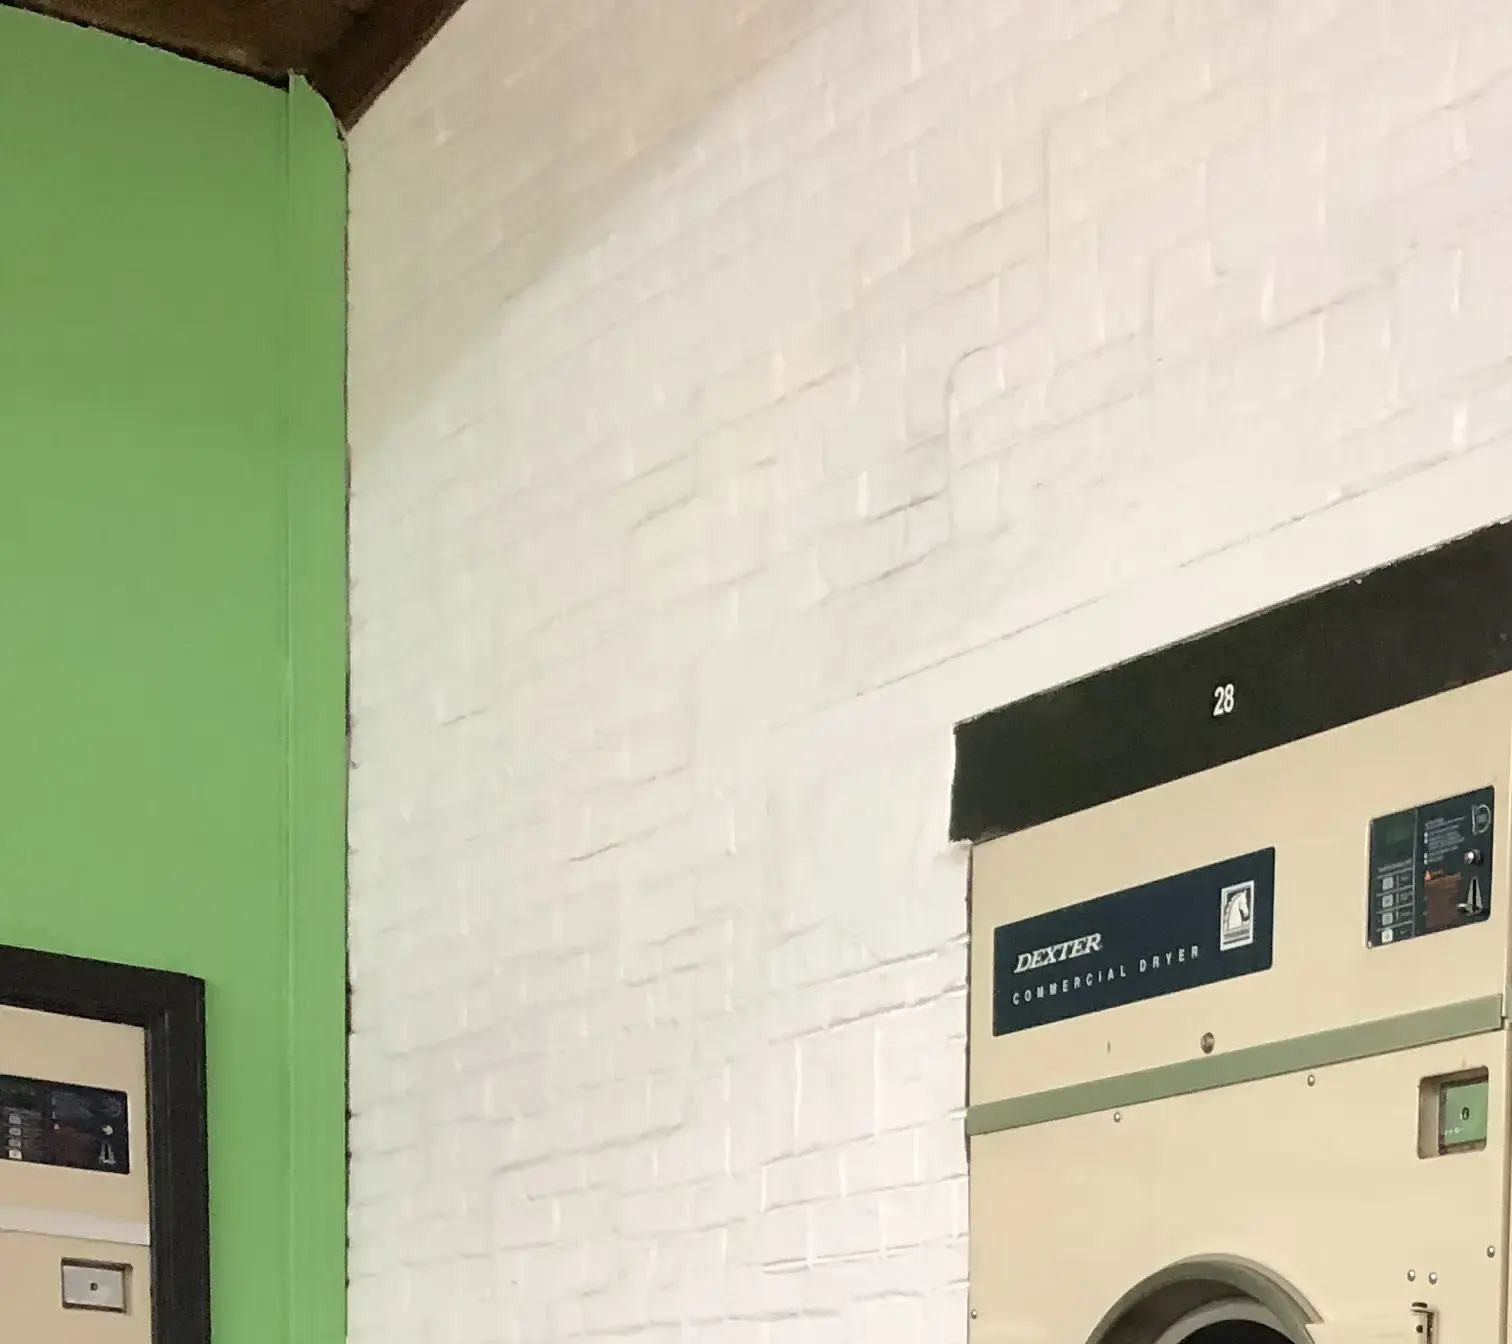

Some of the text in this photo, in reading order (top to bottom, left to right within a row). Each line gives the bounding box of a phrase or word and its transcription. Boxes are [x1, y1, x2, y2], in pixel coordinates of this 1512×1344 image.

[1213, 683, 1235, 717] 28
[1013, 932, 1103, 974] DEXTER
[1012, 945, 1199, 1006] COMMERCIAL DRYER
